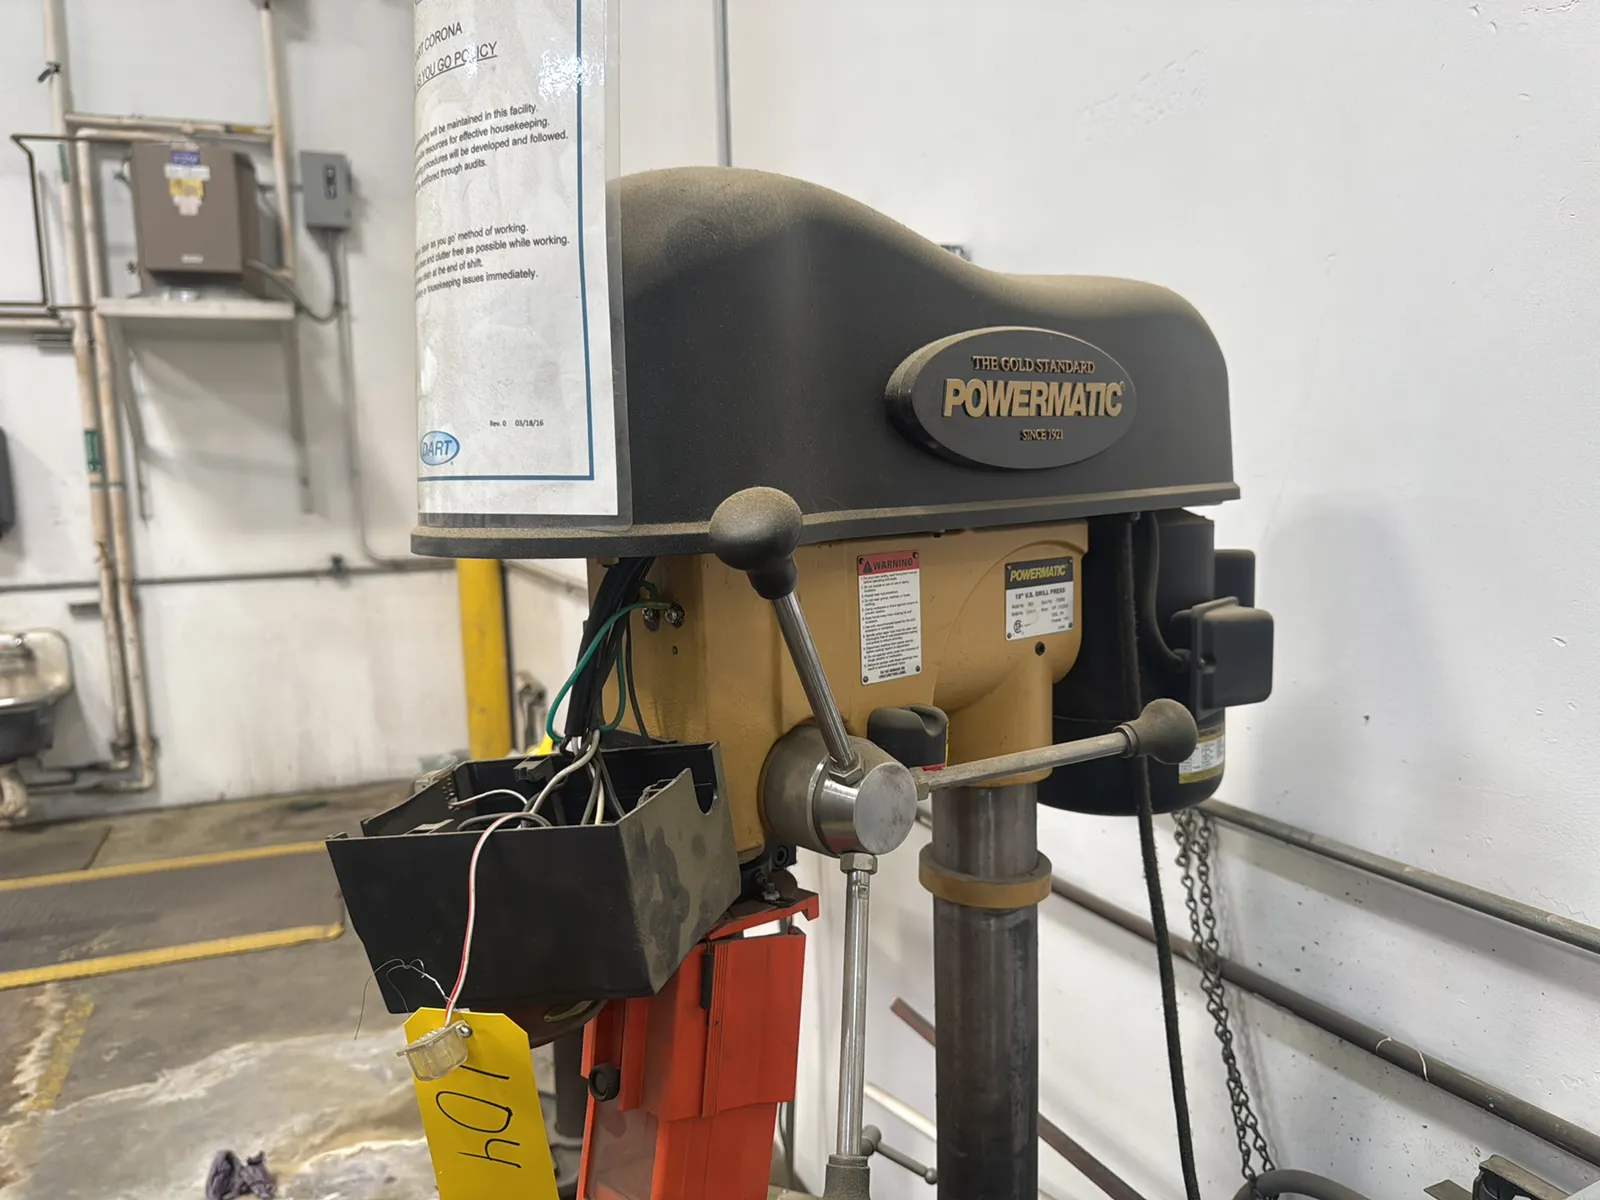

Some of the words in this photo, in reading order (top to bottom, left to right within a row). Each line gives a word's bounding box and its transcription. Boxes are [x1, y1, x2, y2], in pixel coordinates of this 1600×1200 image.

[424, 22, 463, 51] CORONA
[422, 63, 436, 81] YOU
[437, 55, 451, 72] GO
[454, 41, 498, 66] POICY
[438, 124, 446, 135] be
[447, 112, 483, 130] maintained
[484, 110, 492, 121] in
[493, 107, 508, 119] this
[509, 103, 539, 115] facility.
[449, 135, 458, 144] for
[459, 127, 489, 142] effective
[490, 117, 550, 135] housekeeping.
[449, 148, 459, 159] will
[460, 147, 469, 157] be
[470, 137, 510, 154] developed
[512, 134, 528, 147] and
[530, 129, 569, 143] followed.
[440, 162, 463, 178] through
[464, 158, 488, 171] audits.
[457, 227, 484, 241] method
[485, 226, 493, 236] of
[494, 223, 529, 234] working.
[465, 246, 475, 255] as
[475, 239, 507, 254] possible
[508, 238, 531, 248] while
[532, 234, 570, 246] working.
[446, 262, 458, 273] end
[459, 260, 466, 270] of
[462, 274, 485, 284] issues
[485, 268, 539, 282] immediately.
[972, 356, 999, 371] THE
[1000, 357, 1034, 373] GOLD
[1036, 359, 1096, 374] STANDARD
[942, 378, 1123, 418] POWERMATIC
[514, 420, 545, 428] 03/18/16
[1021, 428, 1047, 441] SINCE
[1048, 429, 1064, 441] 1921
[422, 440, 452, 456] DART
[873, 557, 914, 570] WARNING
[1009, 564, 1066, 583] POWERMATIC
[1035, 588, 1050, 597] DRILL
[1050, 587, 1066, 595] PRESS
[436, 1064, 522, 1168] 104
